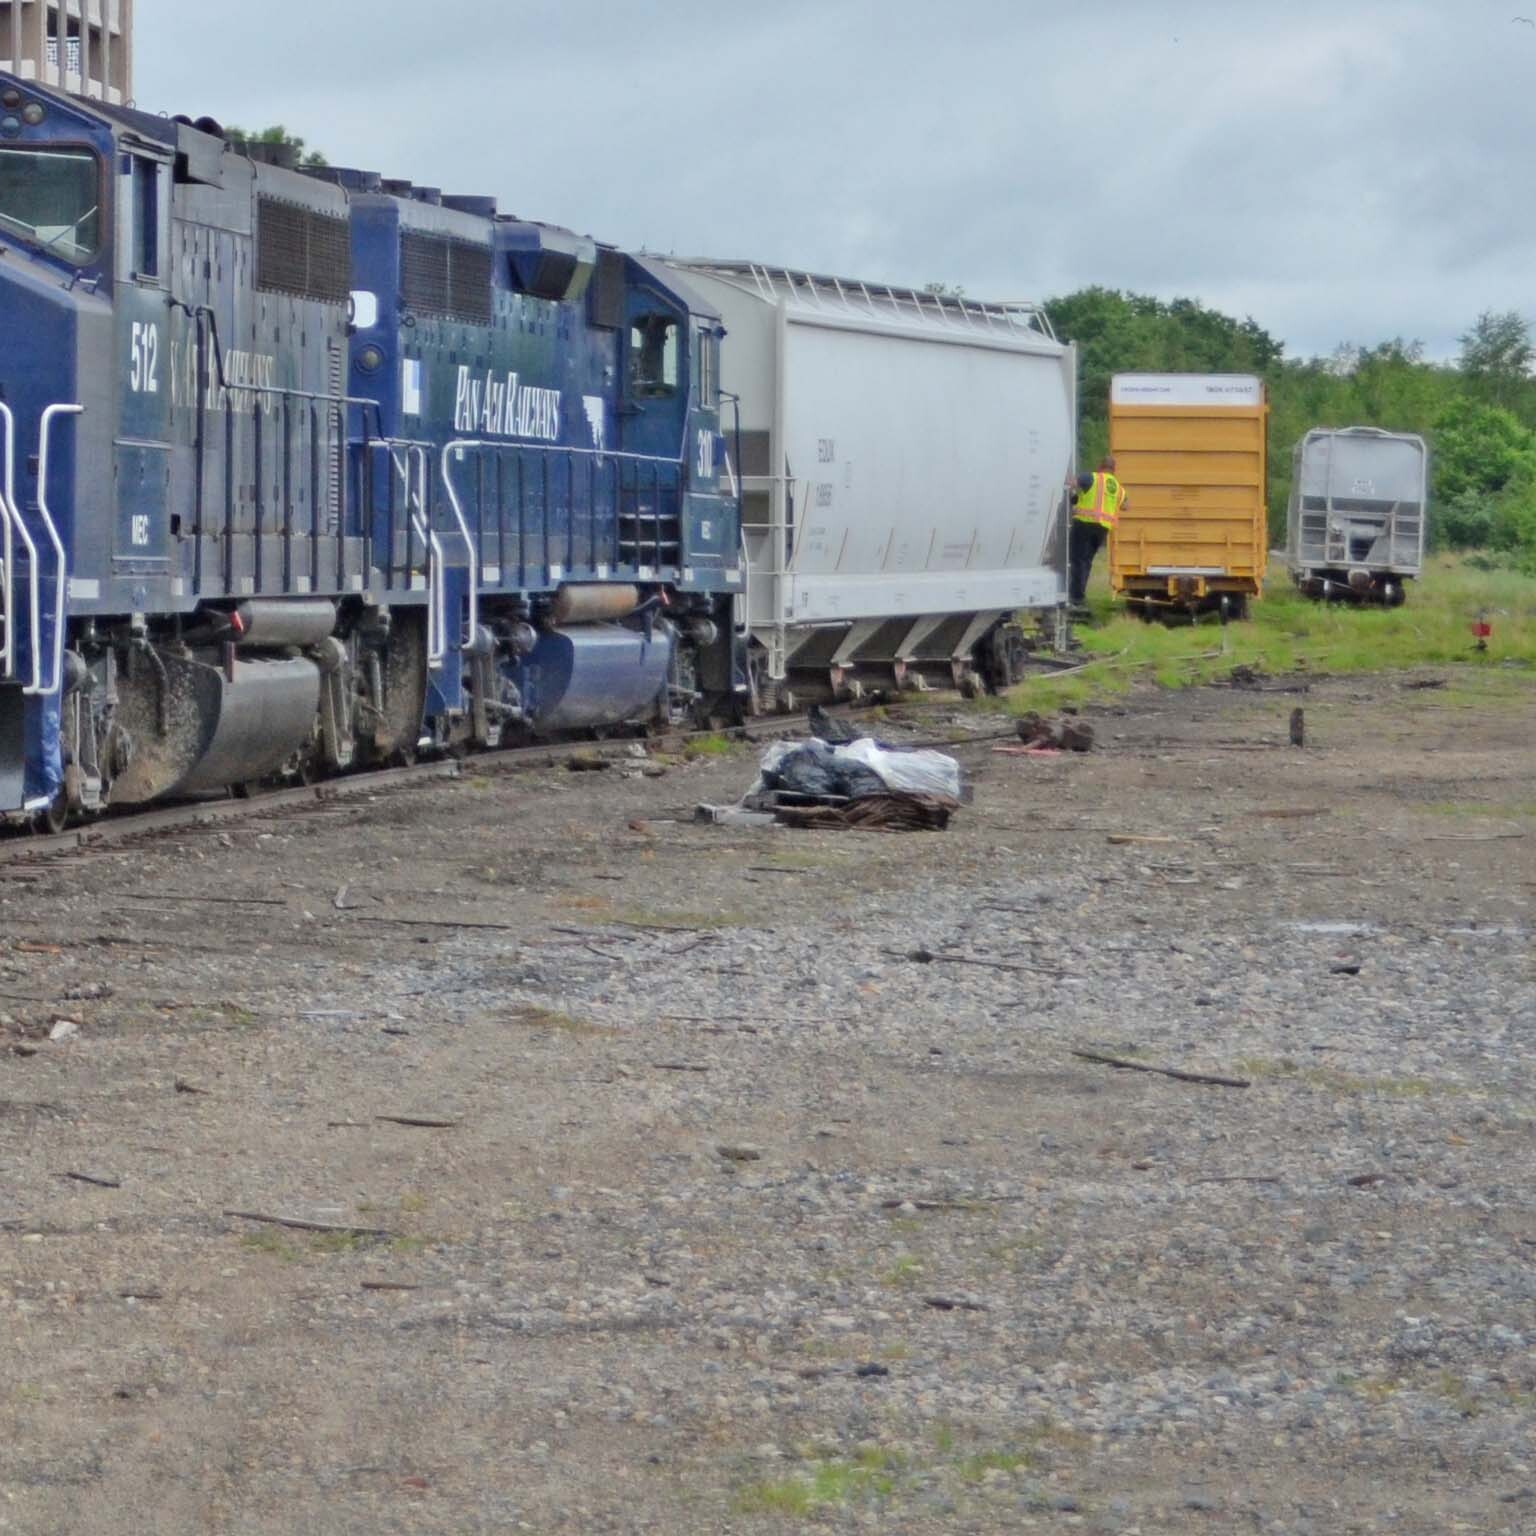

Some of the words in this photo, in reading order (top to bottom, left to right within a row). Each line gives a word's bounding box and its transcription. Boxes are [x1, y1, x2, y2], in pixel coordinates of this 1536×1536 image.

[131, 321, 158, 392] 512
[454, 365, 481, 431] PAN
[481, 369, 504, 433] AM
[505, 372, 561, 441] RAILWAYS
